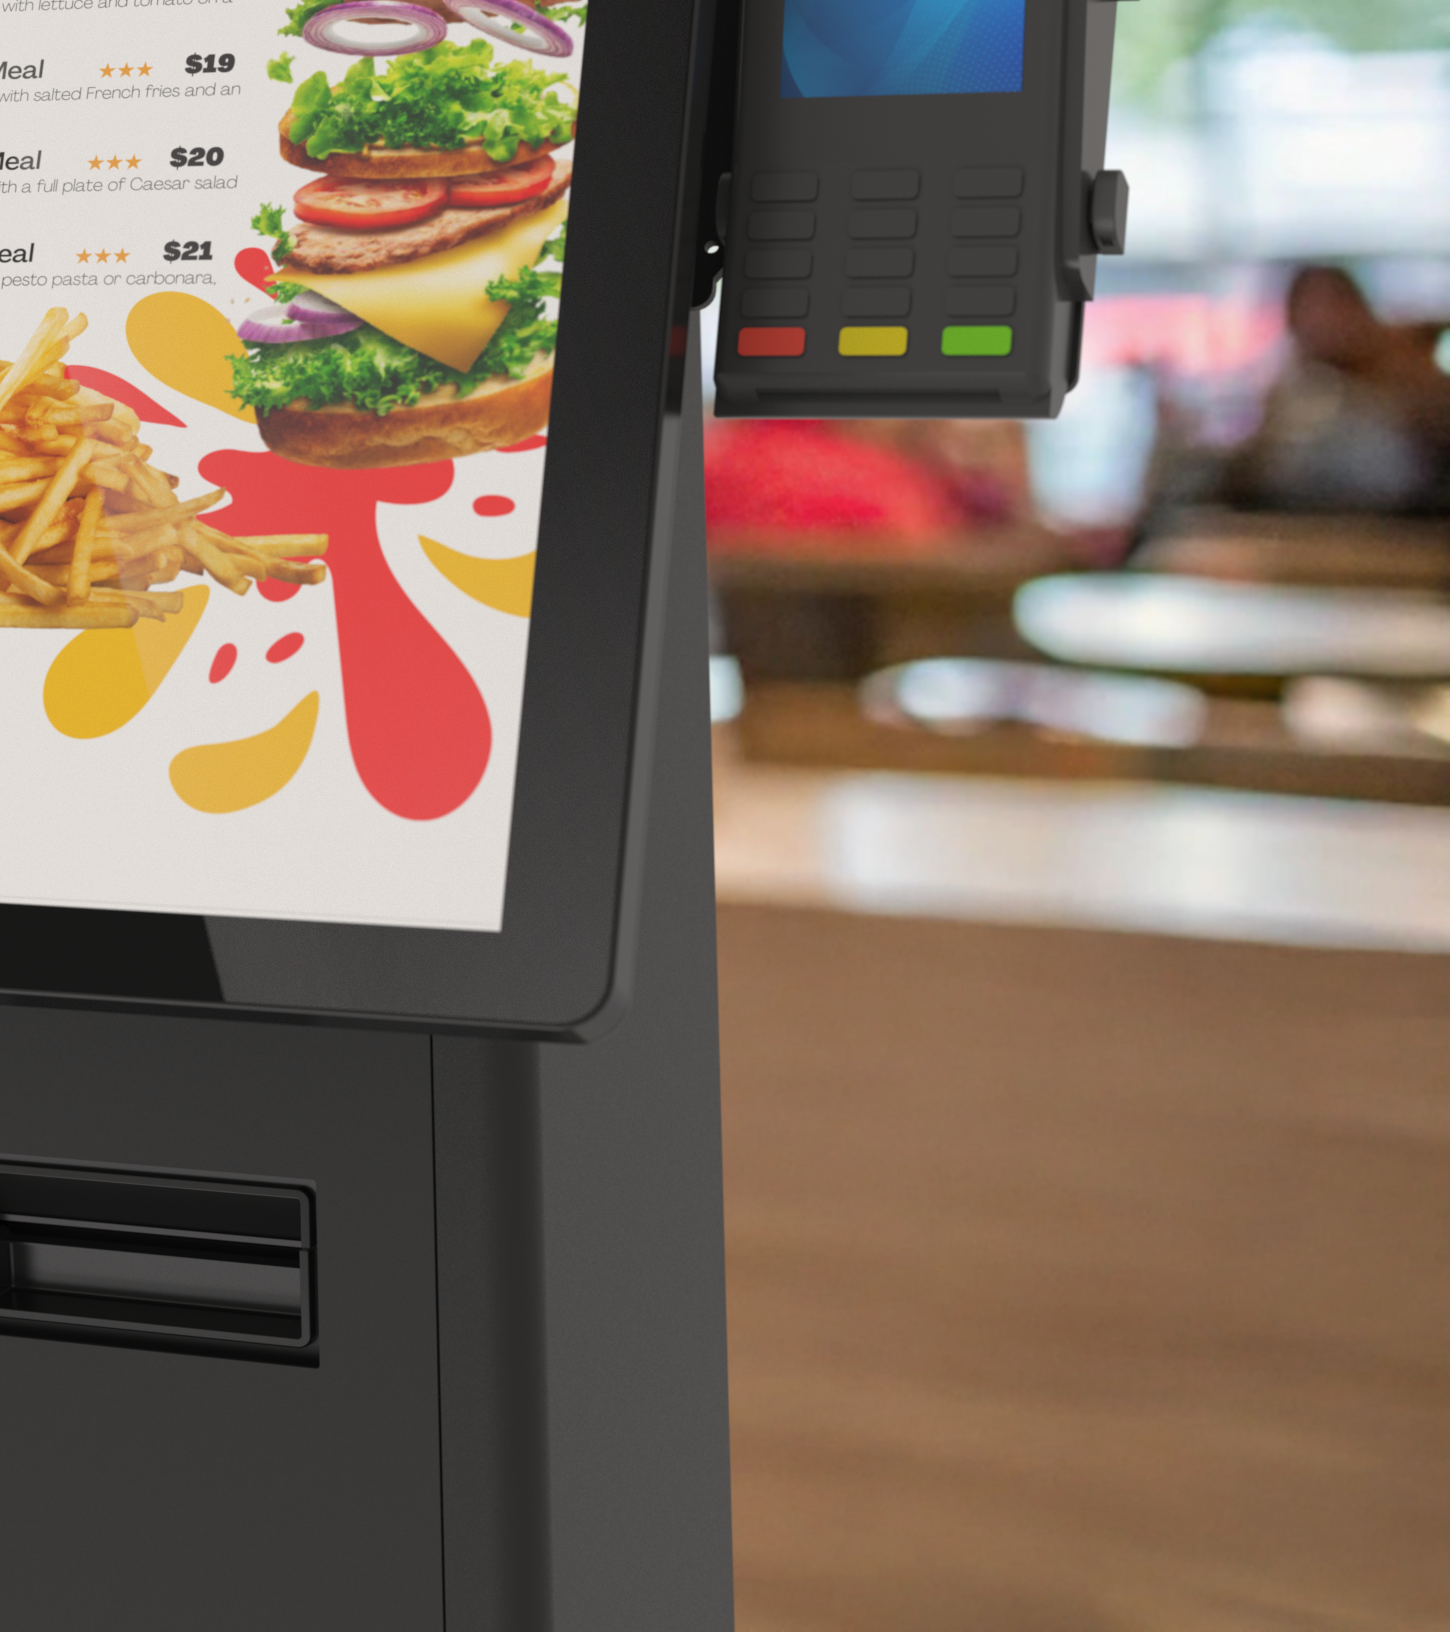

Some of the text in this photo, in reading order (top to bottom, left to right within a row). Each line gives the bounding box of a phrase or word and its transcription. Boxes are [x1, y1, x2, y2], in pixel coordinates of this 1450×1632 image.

[184, 52, 236, 77] $19
[32, 86, 83, 102] salted
[85, 84, 142, 100] French
[145, 83, 181, 99] fries
[183, 82, 217, 98] and
[219, 84, 242, 97] an
[169, 146, 225, 170] $20
[162, 239, 214, 263] $21
[0, 273, 48, 290] pesto
[50, 272, 99, 289] pasta
[102, 274, 122, 286] or
[125, 270, 217, 286] carbonara,
